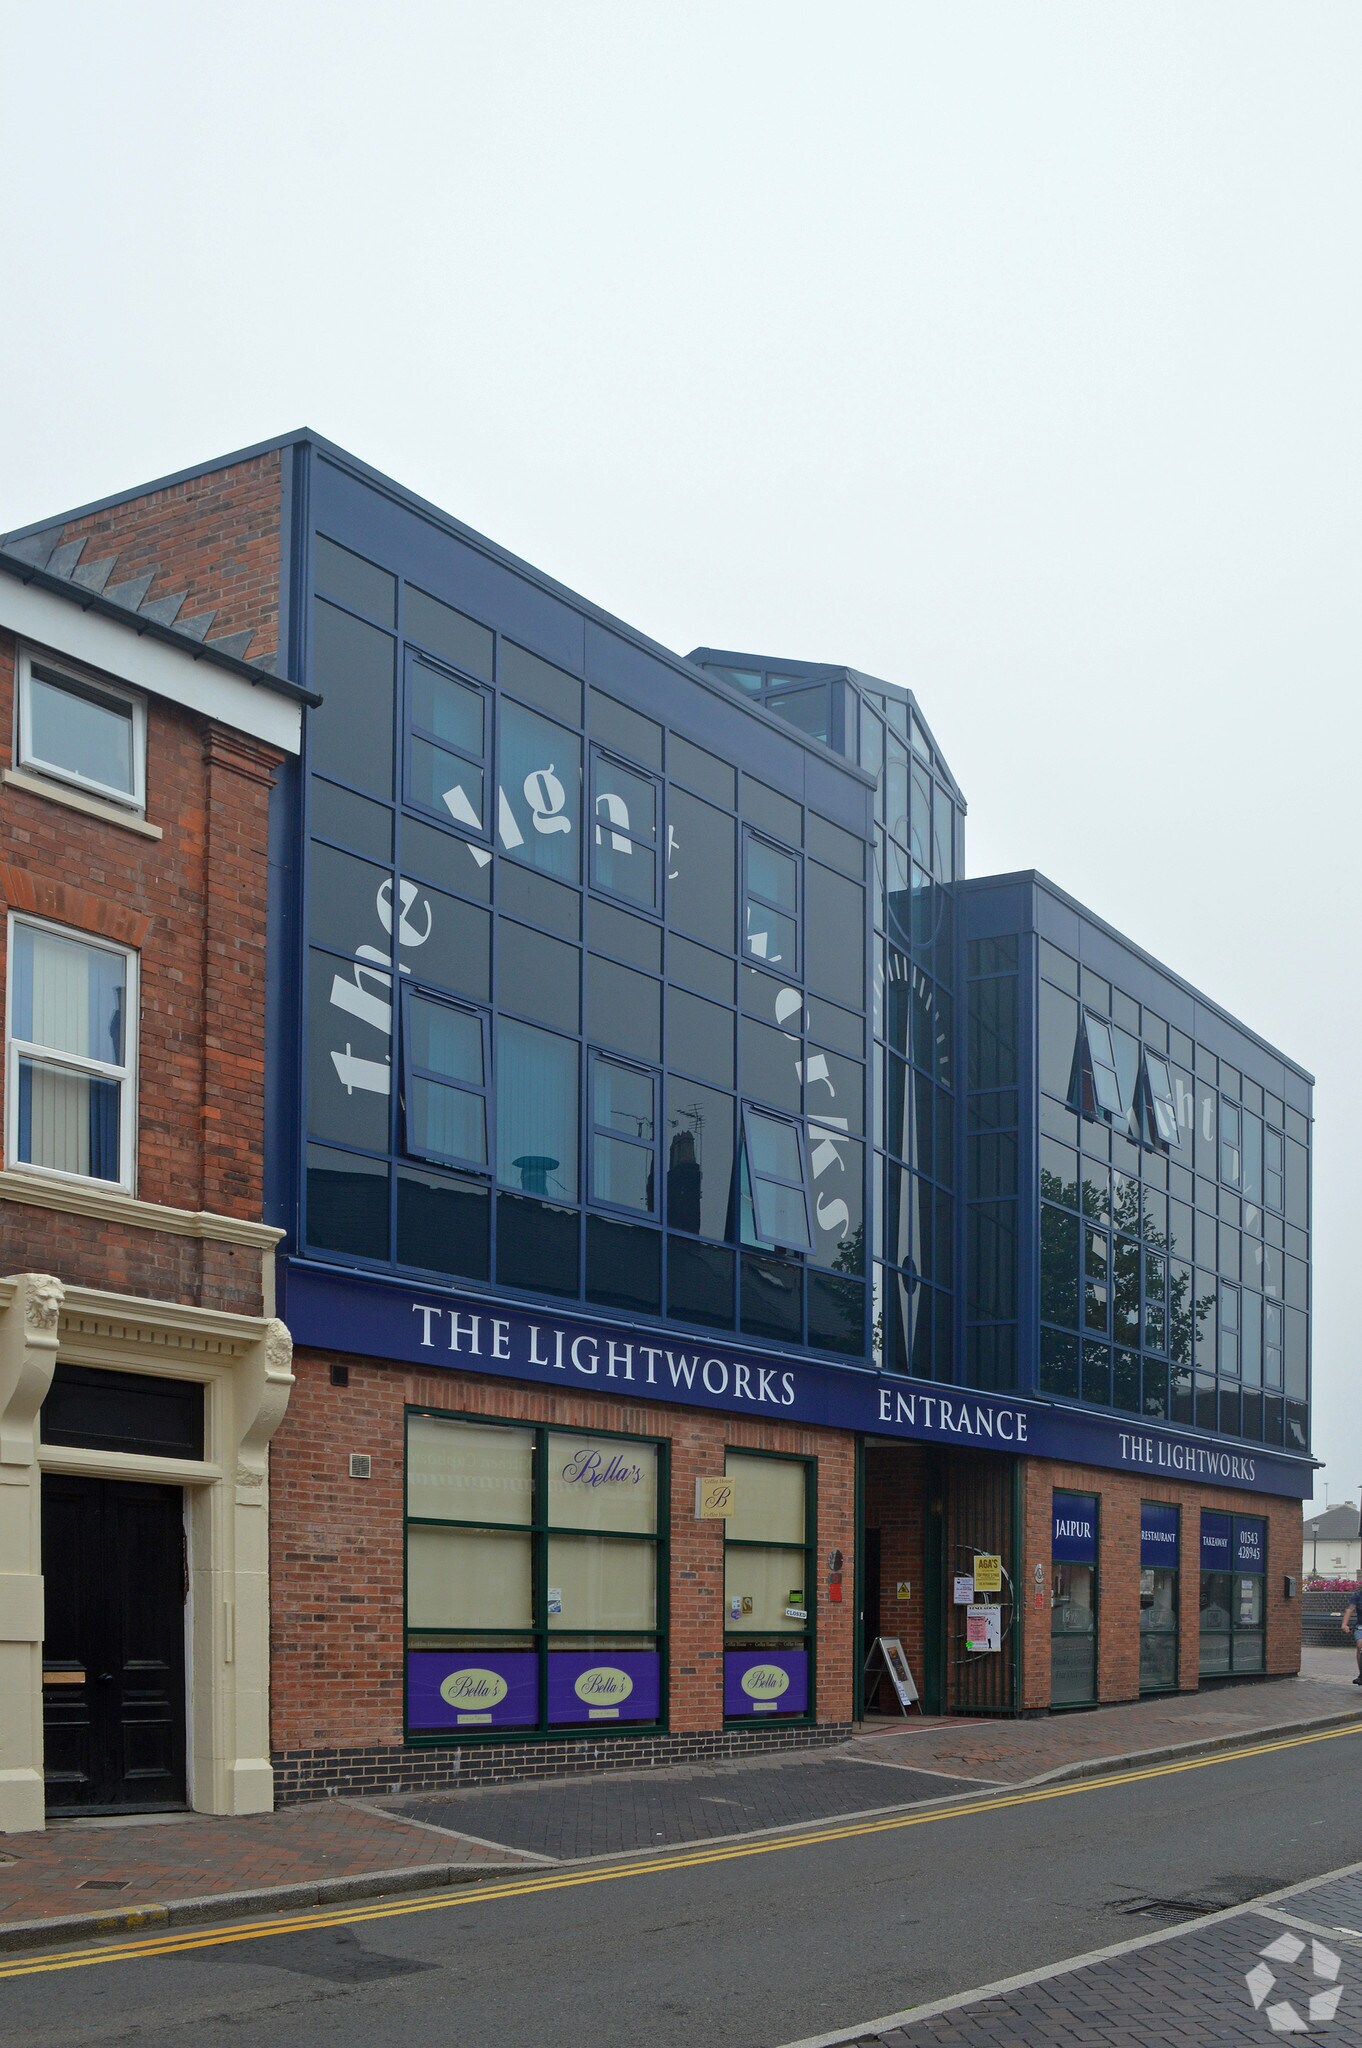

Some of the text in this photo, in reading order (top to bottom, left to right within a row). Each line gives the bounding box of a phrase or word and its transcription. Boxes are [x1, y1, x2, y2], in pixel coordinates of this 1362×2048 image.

[411, 1303, 796, 1406] THE LIGHTWORKS
[878, 1388, 1028, 1442] ENTRANCE
[1118, 1433, 1256, 1481] THE LIGHTWORKS
[562, 1449, 645, 1488] Bella's
[704, 1486, 731, 1510] B
[1055, 1519, 1092, 1539] JAIPUR
[1141, 1530, 1176, 1543] RESTAURANT
[1240, 1530, 1258, 1545] 01543
[1202, 1536, 1229, 1548] TAKEAWAY
[1237, 1546, 1261, 1560] 428945
[786, 1609, 807, 1618] CLOSED
[447, 1675, 500, 1699] Bella's
[581, 1673, 626, 1695] Bella's
[747, 1670, 784, 1690] Bella's
